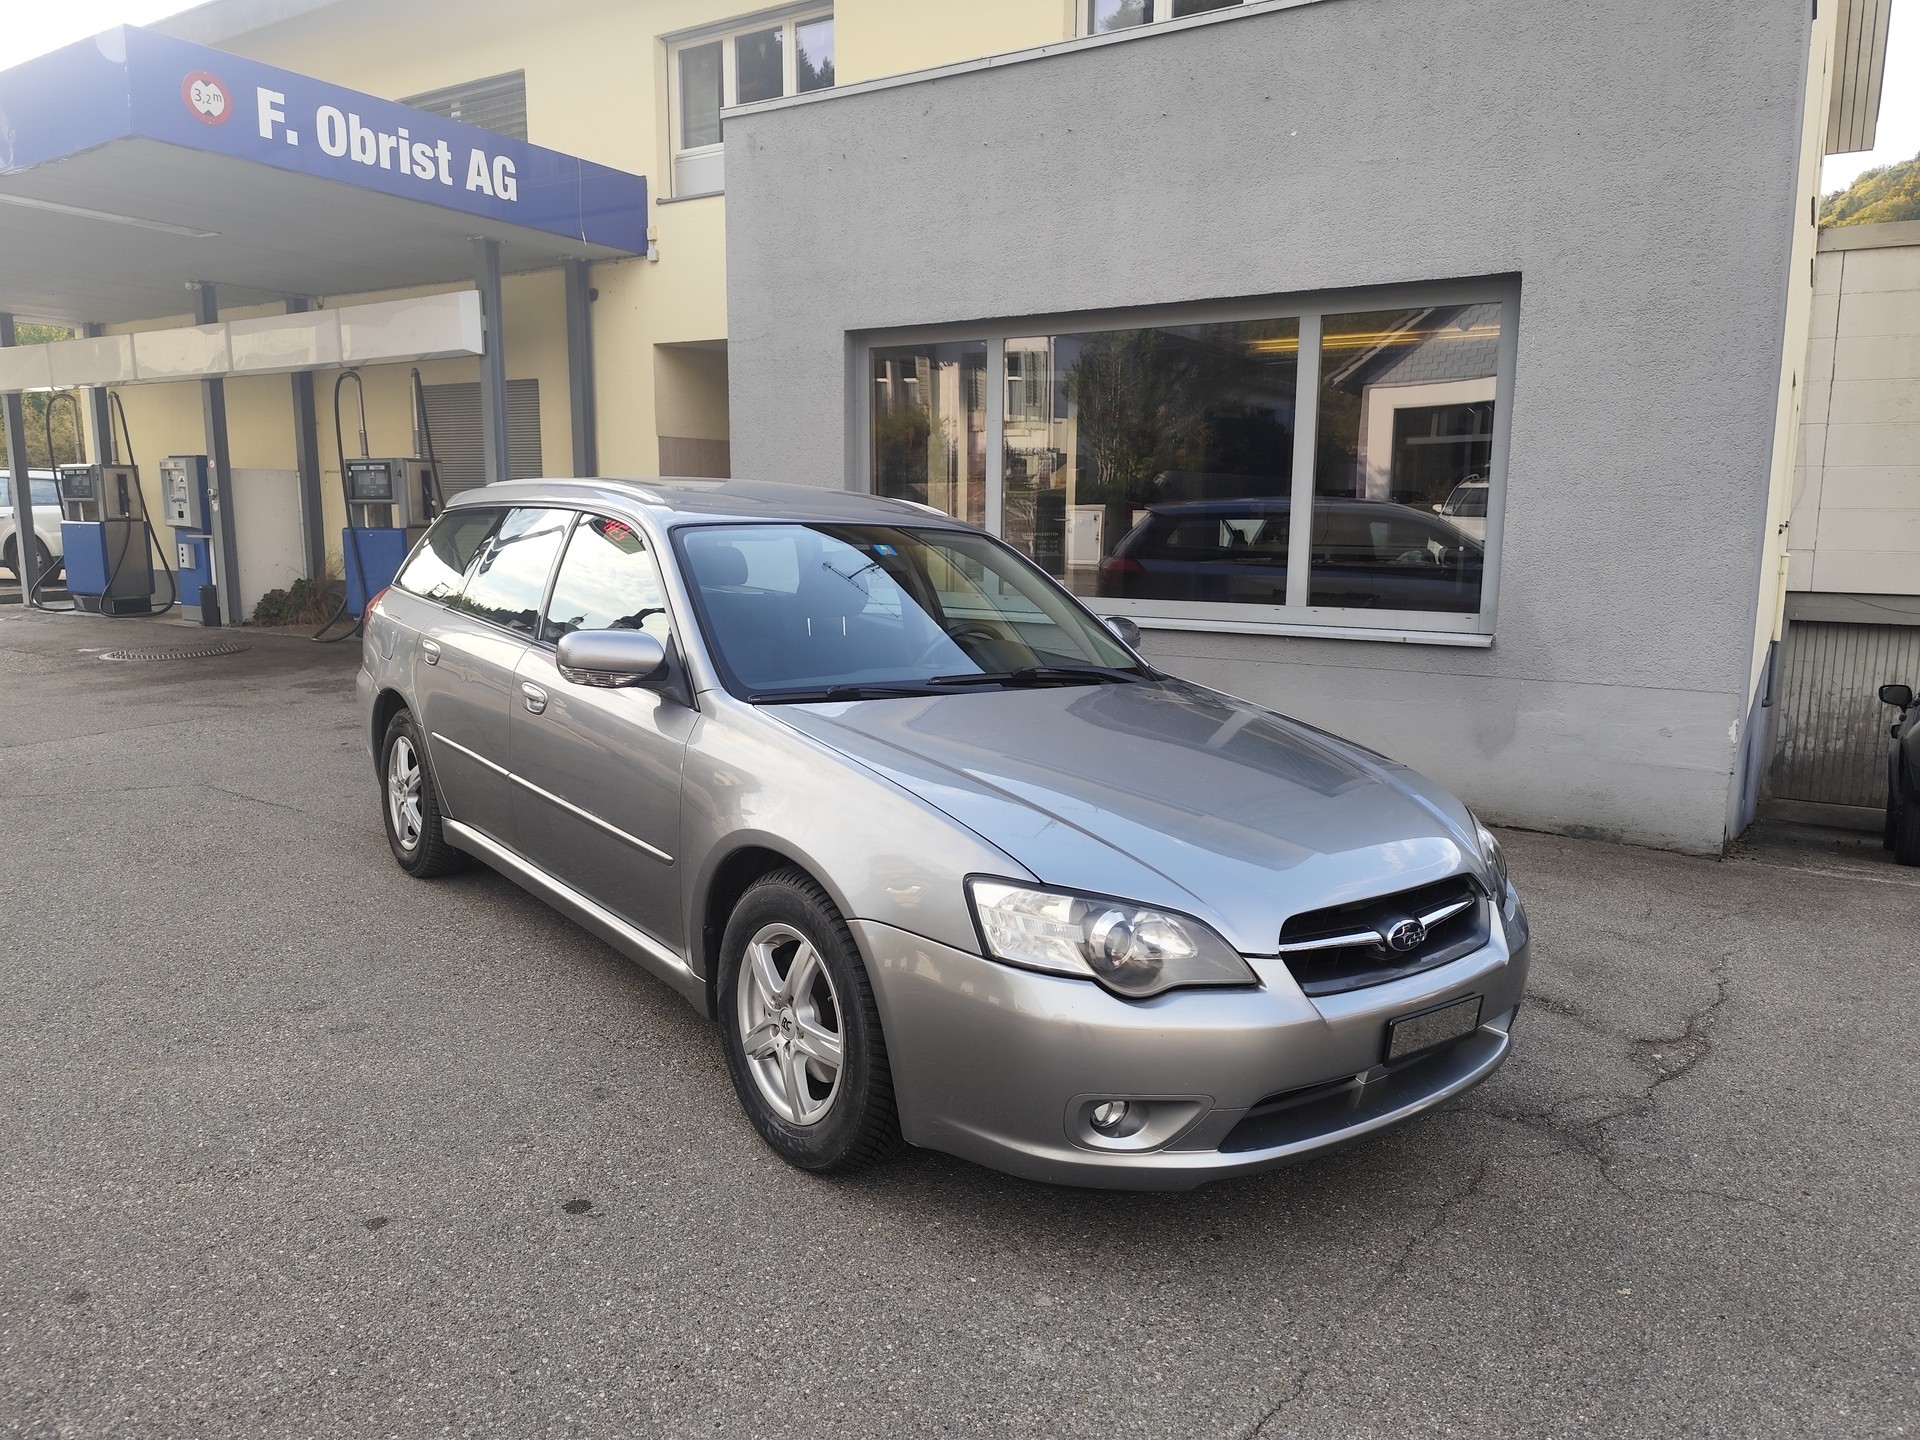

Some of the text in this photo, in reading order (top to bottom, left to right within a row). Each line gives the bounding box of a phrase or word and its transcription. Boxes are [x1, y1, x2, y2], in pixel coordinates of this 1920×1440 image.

[256, 86, 518, 202] F. Obrist AG
[397, 468, 402, 478] 4
